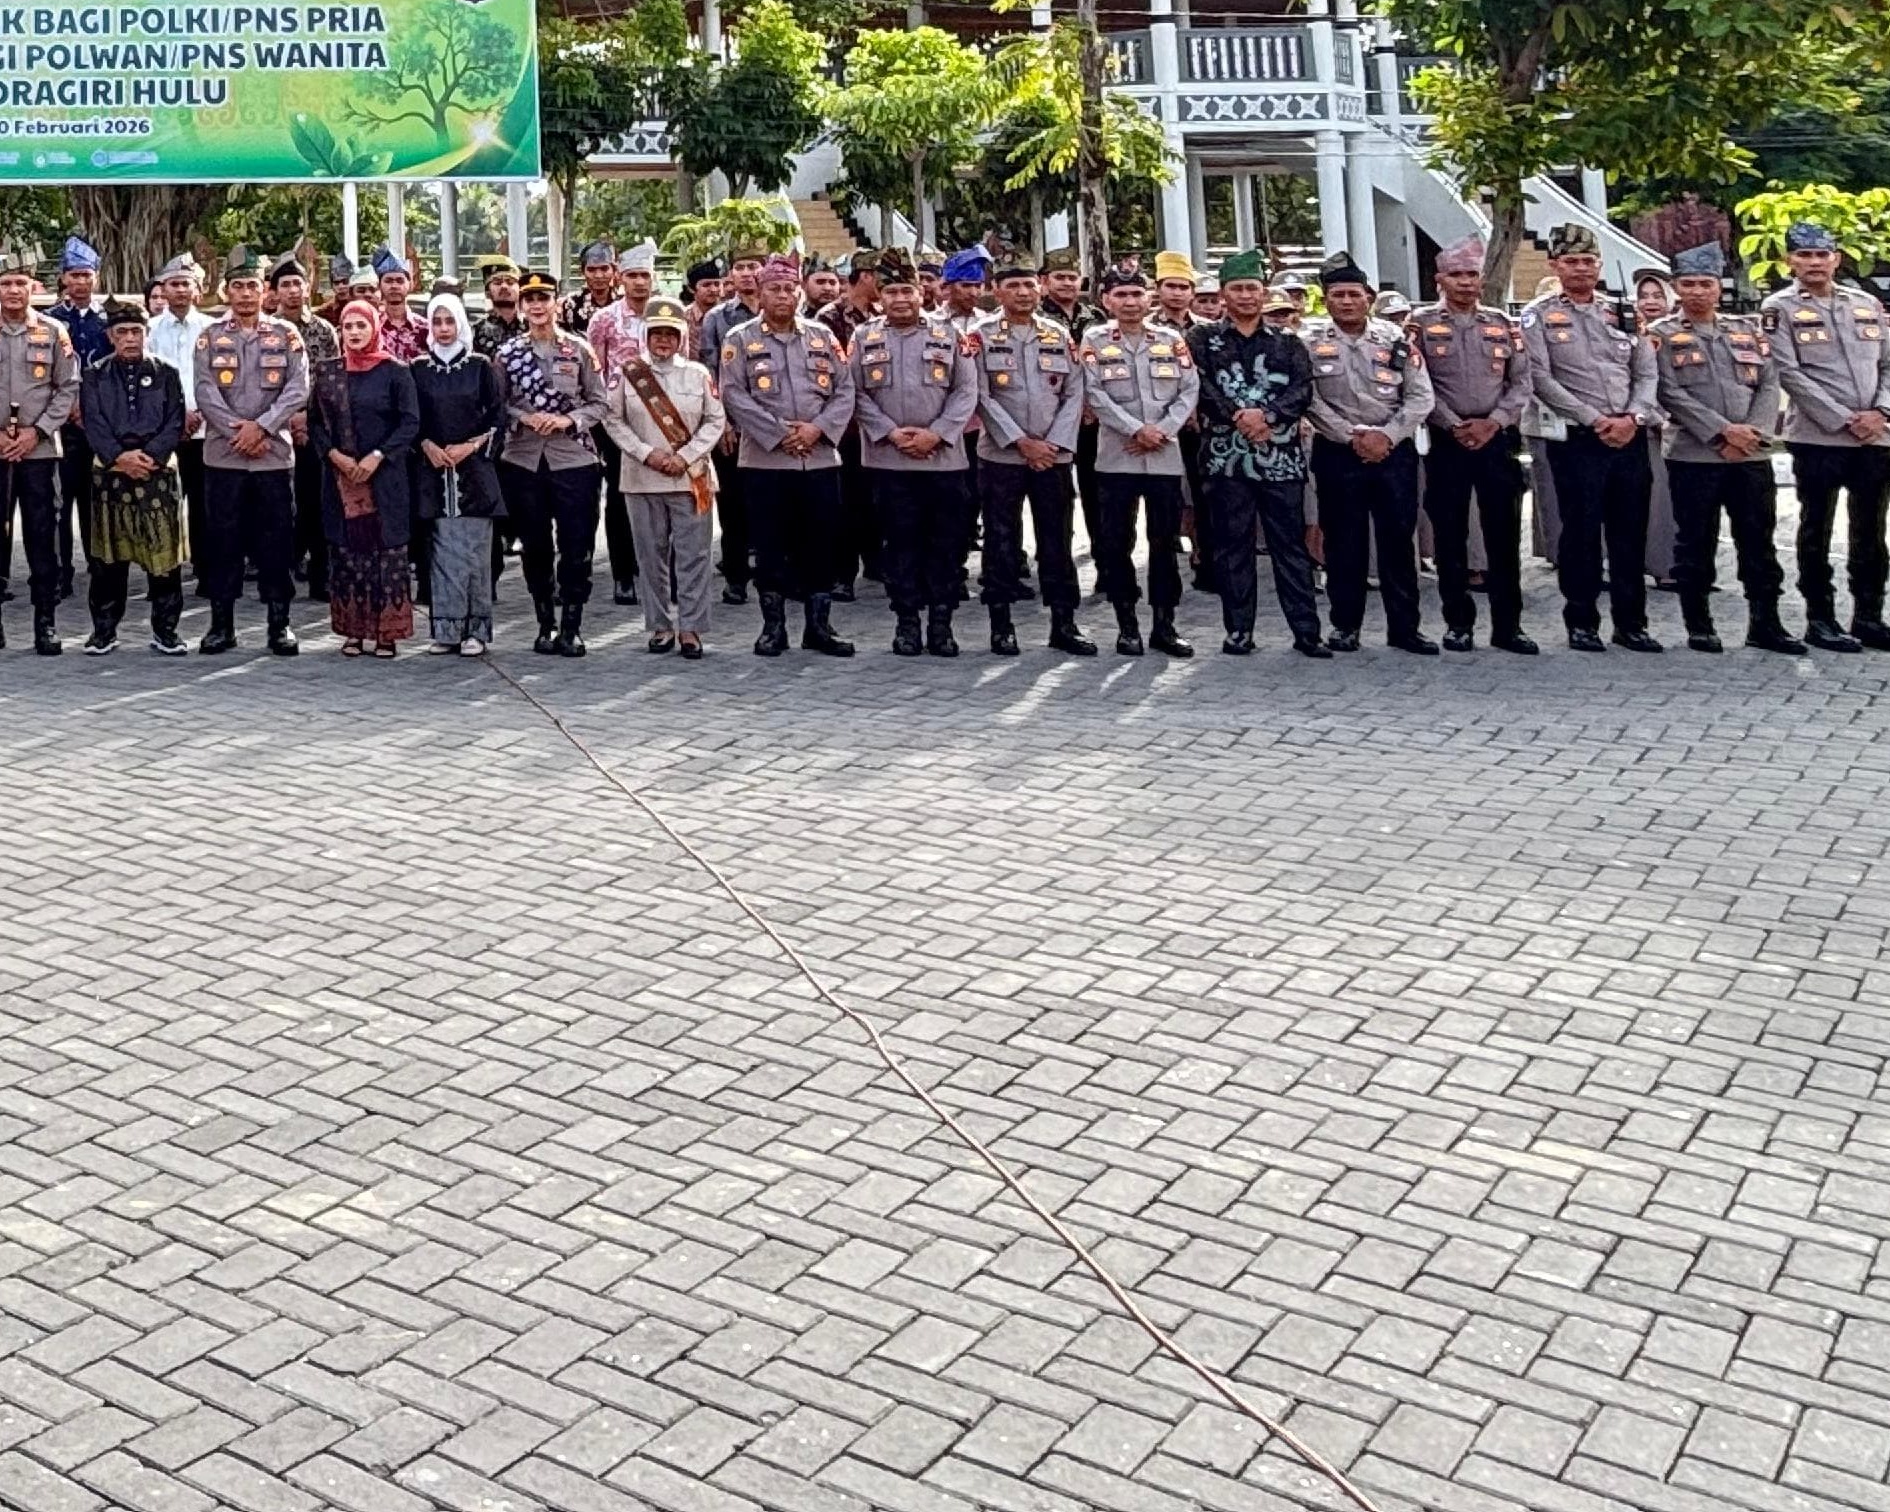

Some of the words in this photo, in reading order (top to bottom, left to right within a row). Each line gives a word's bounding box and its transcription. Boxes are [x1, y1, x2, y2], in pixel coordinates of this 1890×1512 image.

[34, 9, 110, 34] BAGI
[120, 7, 298, 34] POLKI/PNS
[307, 7, 385, 33] PRIA
[26, 43, 246, 70] POLWAN/PNS
[253, 43, 386, 68] WANITA
[133, 79, 226, 105] HULU
[14, 119, 99, 134] Februari
[104, 120, 150, 134] 2026
